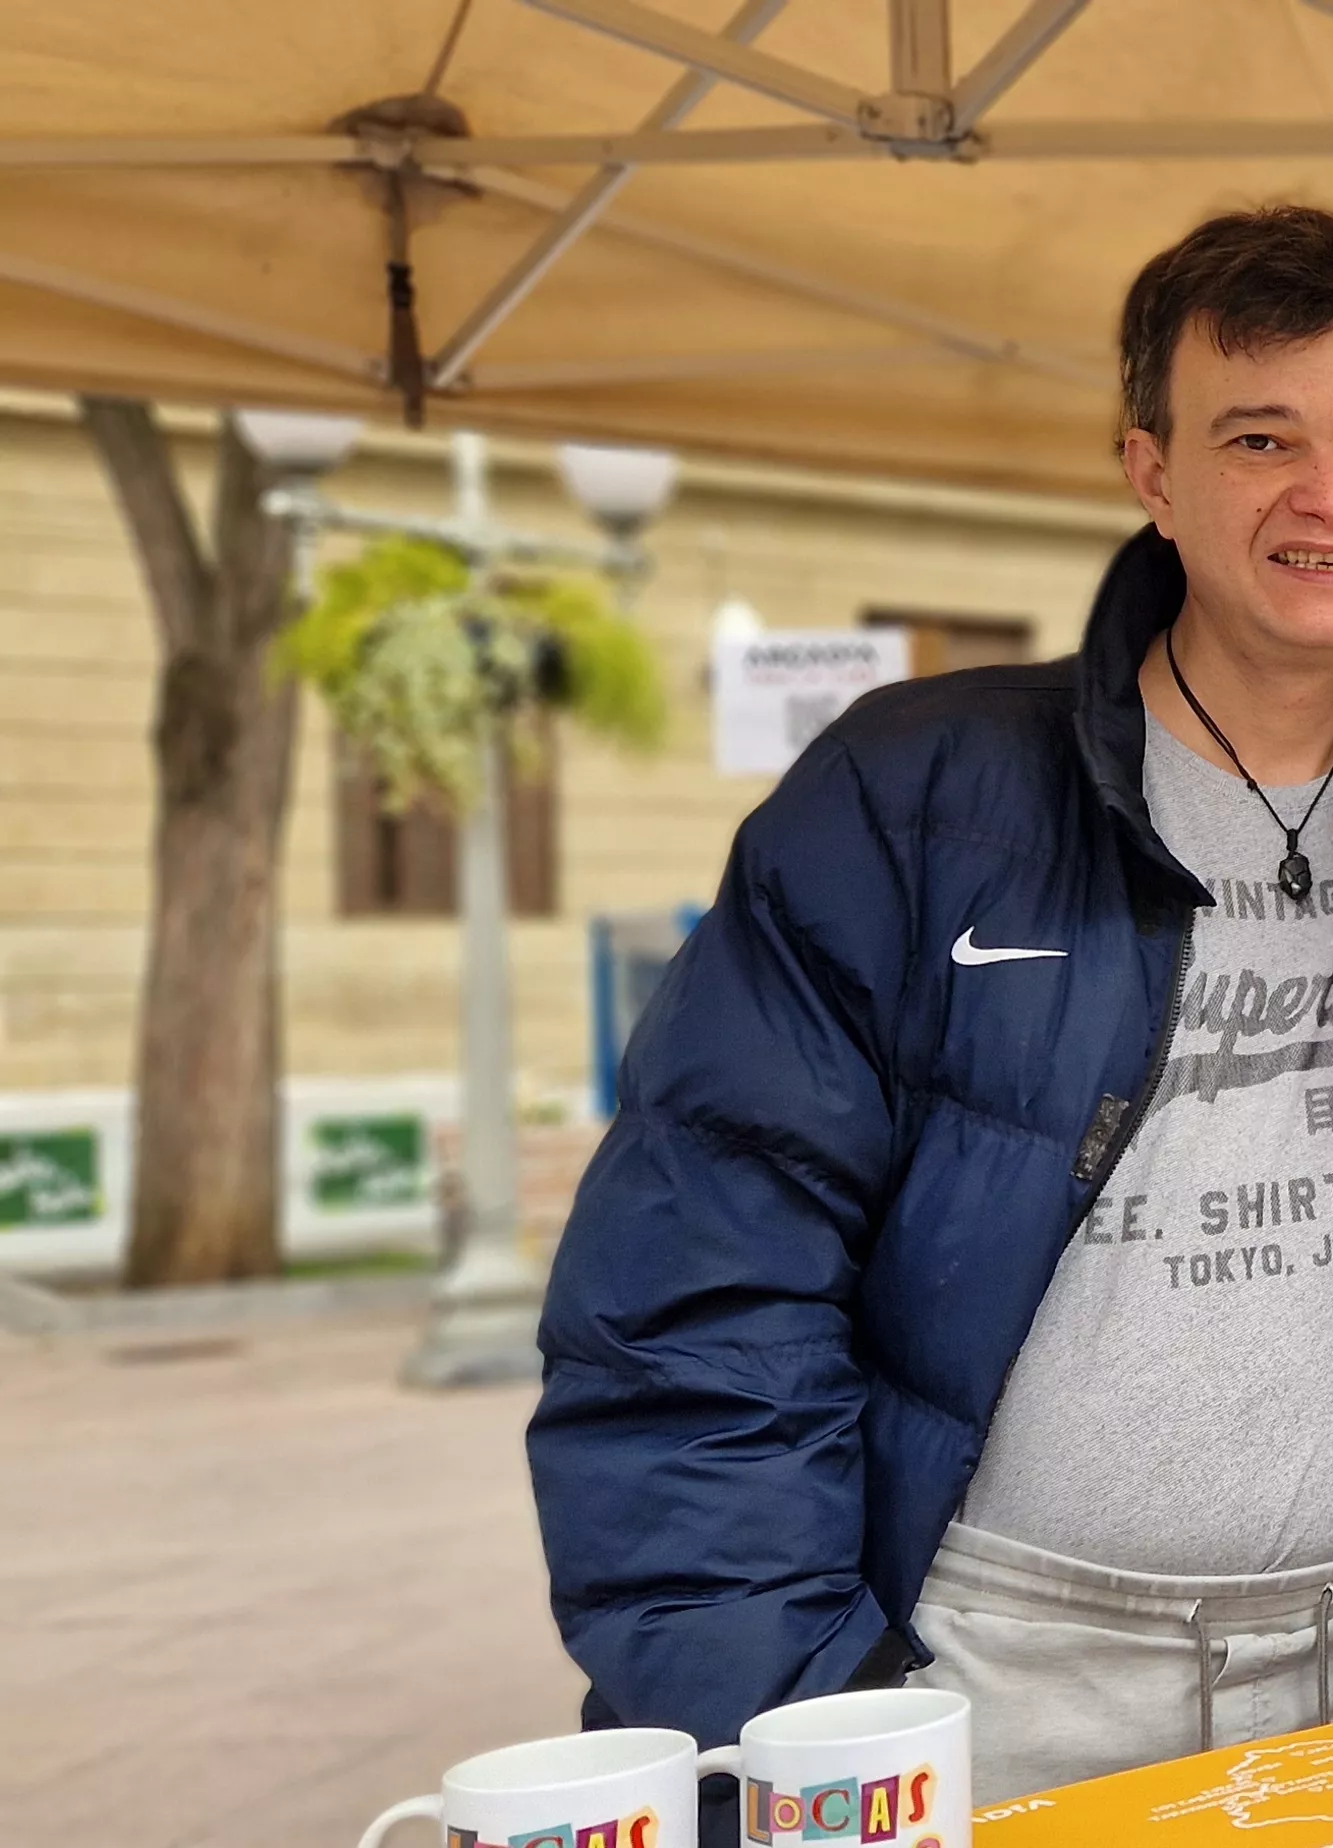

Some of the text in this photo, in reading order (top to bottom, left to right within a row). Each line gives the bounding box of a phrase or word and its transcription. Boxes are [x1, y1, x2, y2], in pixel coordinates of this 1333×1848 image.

[1084, 1195, 1163, 1245] EE.
[1163, 1243, 1294, 1289] TOKYO,
[747, 1772, 929, 1841] LOCAS
